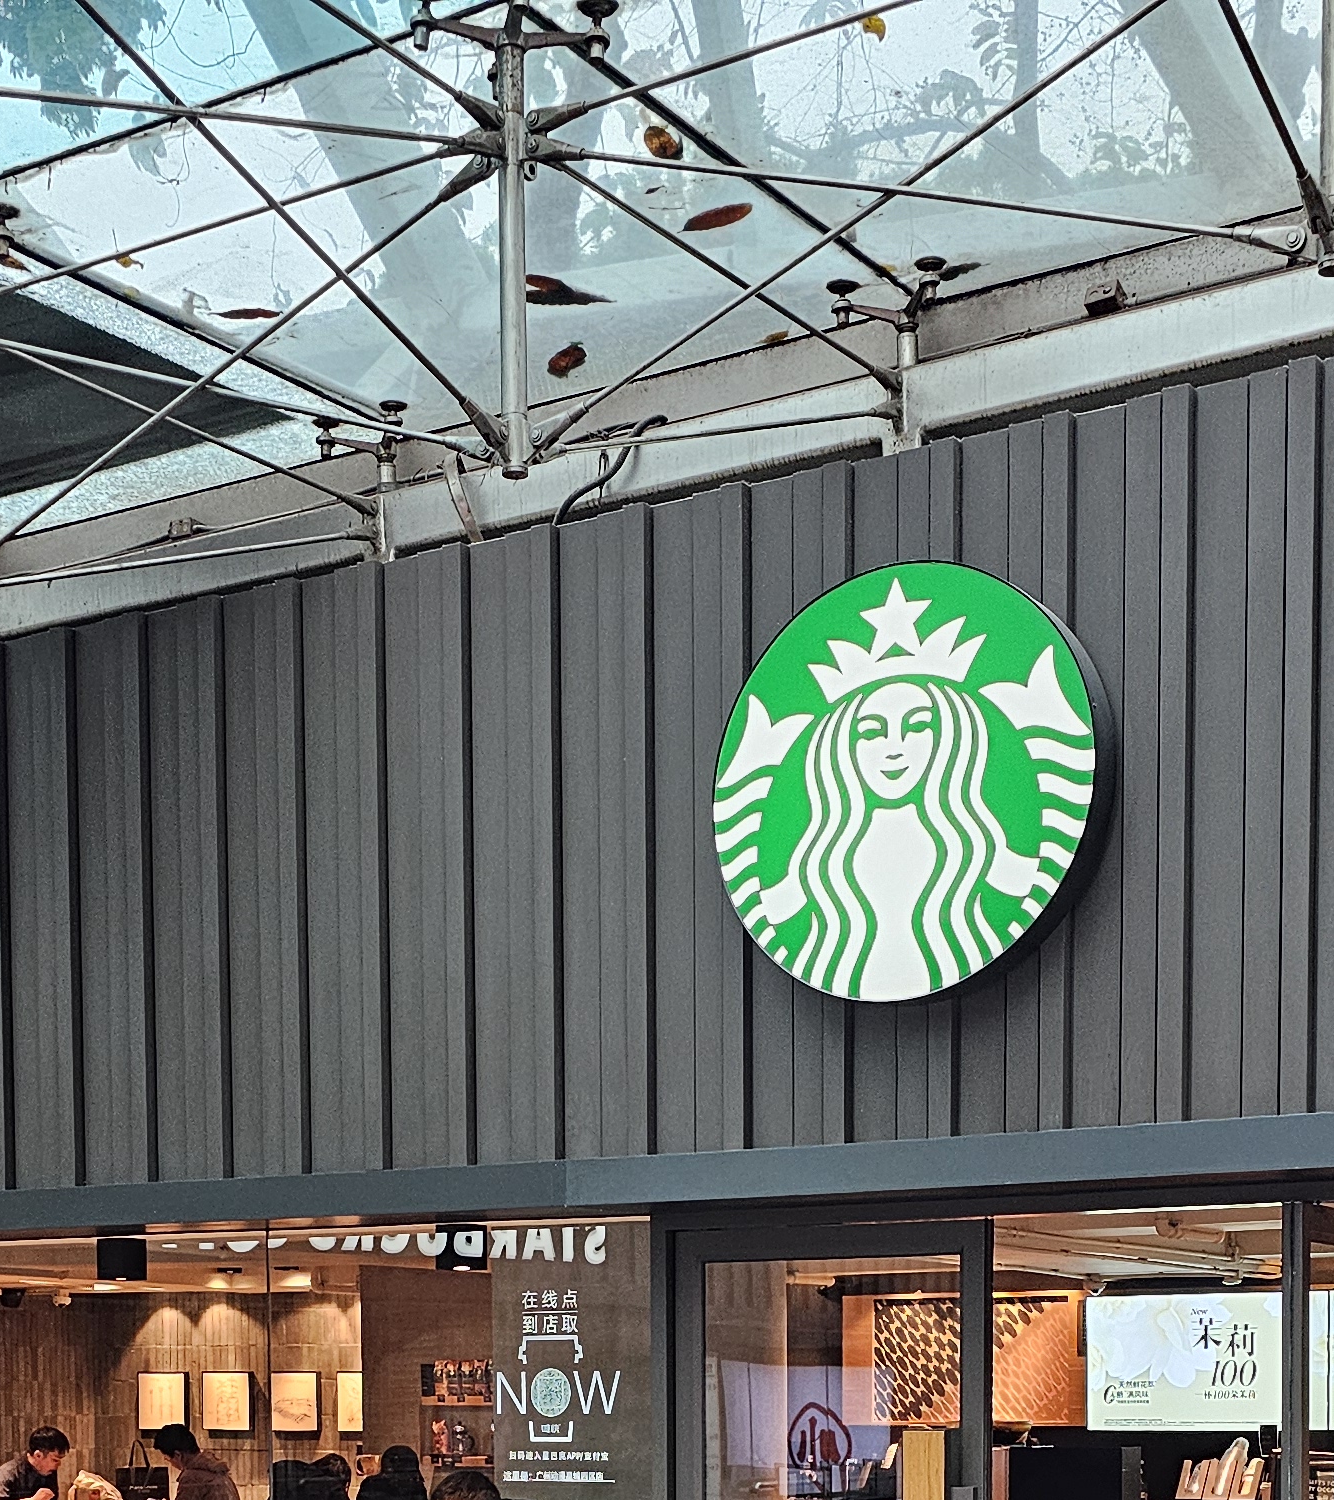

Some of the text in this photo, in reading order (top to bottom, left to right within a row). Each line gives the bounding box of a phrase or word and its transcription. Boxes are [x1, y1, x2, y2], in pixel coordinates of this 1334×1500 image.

[522, 1289, 578, 1309] 在线点
[522, 1314, 578, 1334] 到店取
[1191, 1317, 1258, 1358] 茉莉
[1210, 1359, 1258, 1387] 100
